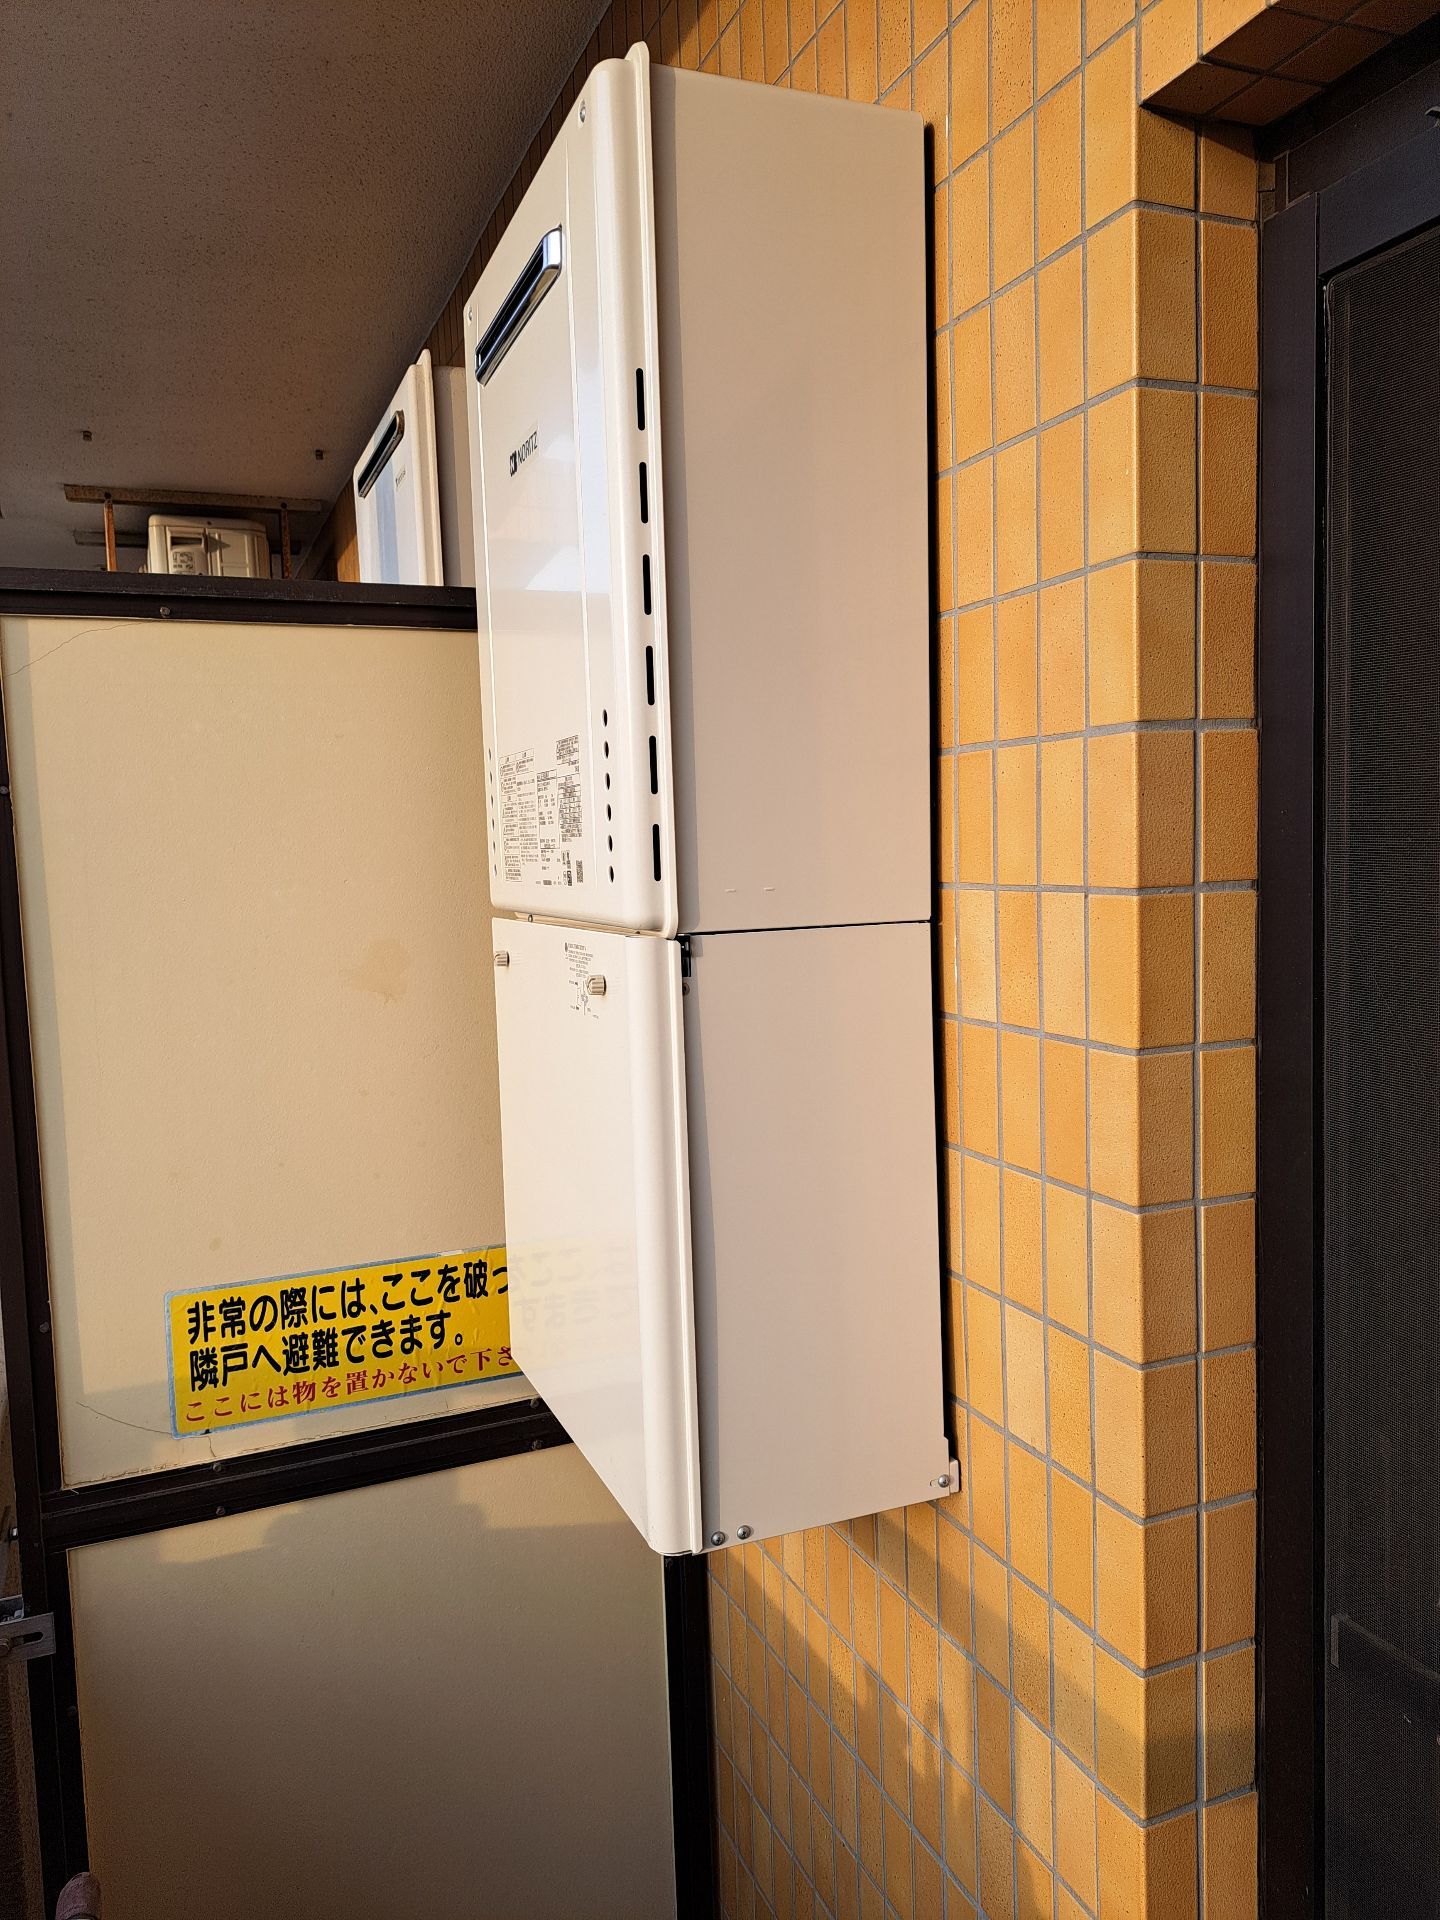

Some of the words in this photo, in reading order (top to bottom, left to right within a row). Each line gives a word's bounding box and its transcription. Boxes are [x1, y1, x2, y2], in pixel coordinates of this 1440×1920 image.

[517, 431, 539, 465] NORITZ
[189, 1309, 464, 1393] 隣戸へ避難できます。
